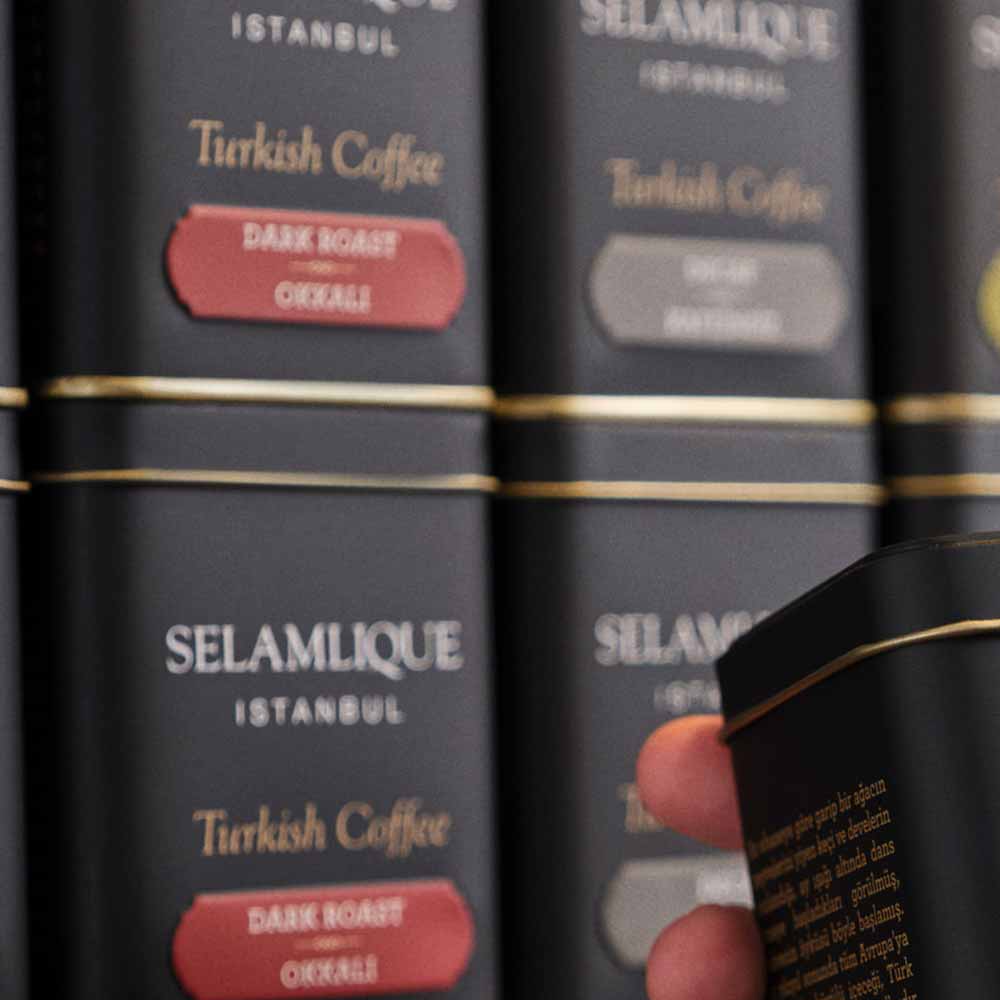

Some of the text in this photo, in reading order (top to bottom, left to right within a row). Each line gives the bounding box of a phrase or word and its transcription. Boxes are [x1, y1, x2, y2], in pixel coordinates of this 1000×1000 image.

[231, 11, 400, 58] ISTANBUL
[188, 118, 445, 192] Turkish Coffee
[165, 620, 466, 681] SELAMLIQUE
[235, 695, 406, 728] ISTANBUL
[853, 777, 888, 808] ağacın
[192, 798, 453, 860] Turkish Coffee
[847, 807, 892, 841] develerin
[869, 839, 896, 862] dans
[850, 867, 901, 909] görülmüş,
[856, 901, 905, 936] başlamış.
[858, 929, 910, 966] Avrupa'ya
[885, 955, 914, 985] Türk
